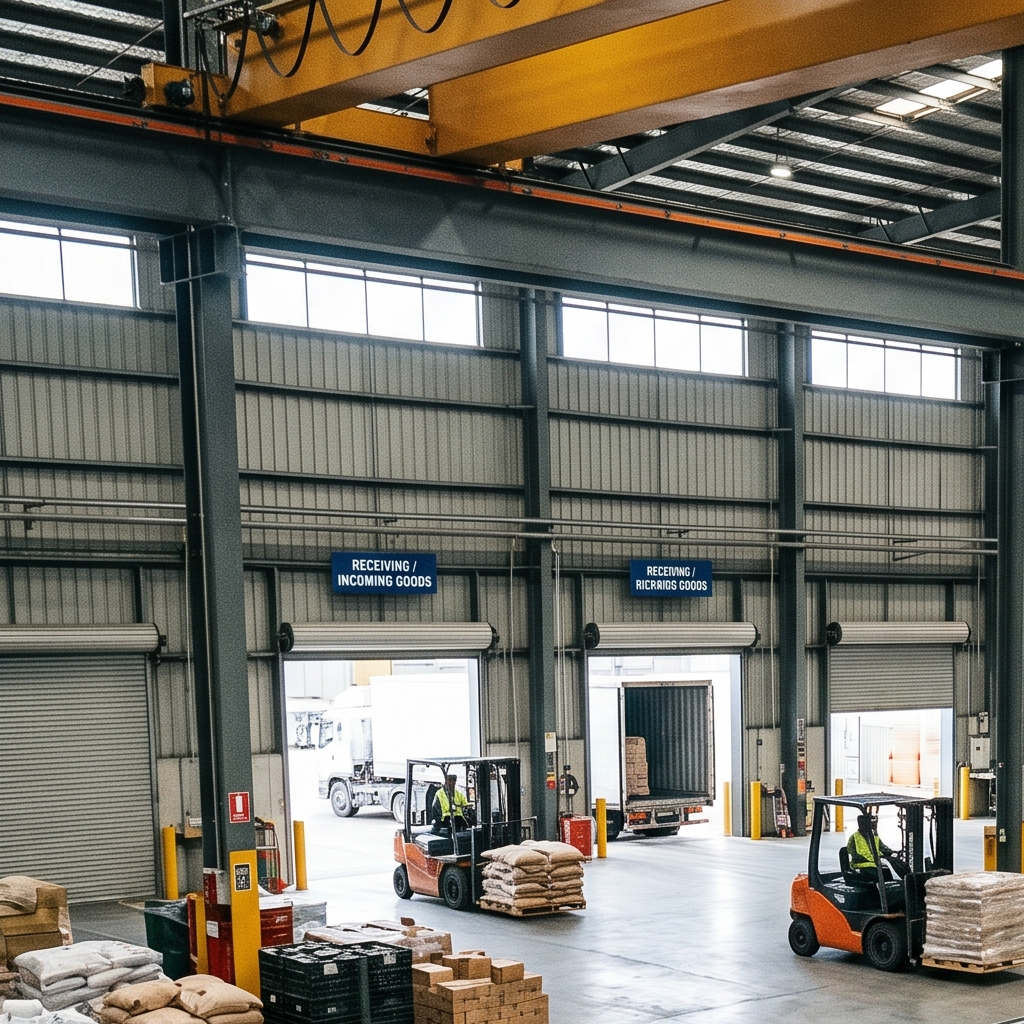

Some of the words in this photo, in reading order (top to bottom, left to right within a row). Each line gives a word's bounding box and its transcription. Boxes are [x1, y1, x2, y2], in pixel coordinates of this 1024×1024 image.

[352, 559, 410, 572] RECEIVING
[412, 560, 417, 573] /
[691, 567, 696, 578] /
[337, 574, 393, 587] INCOMING
[395, 575, 432, 588] GOODS
